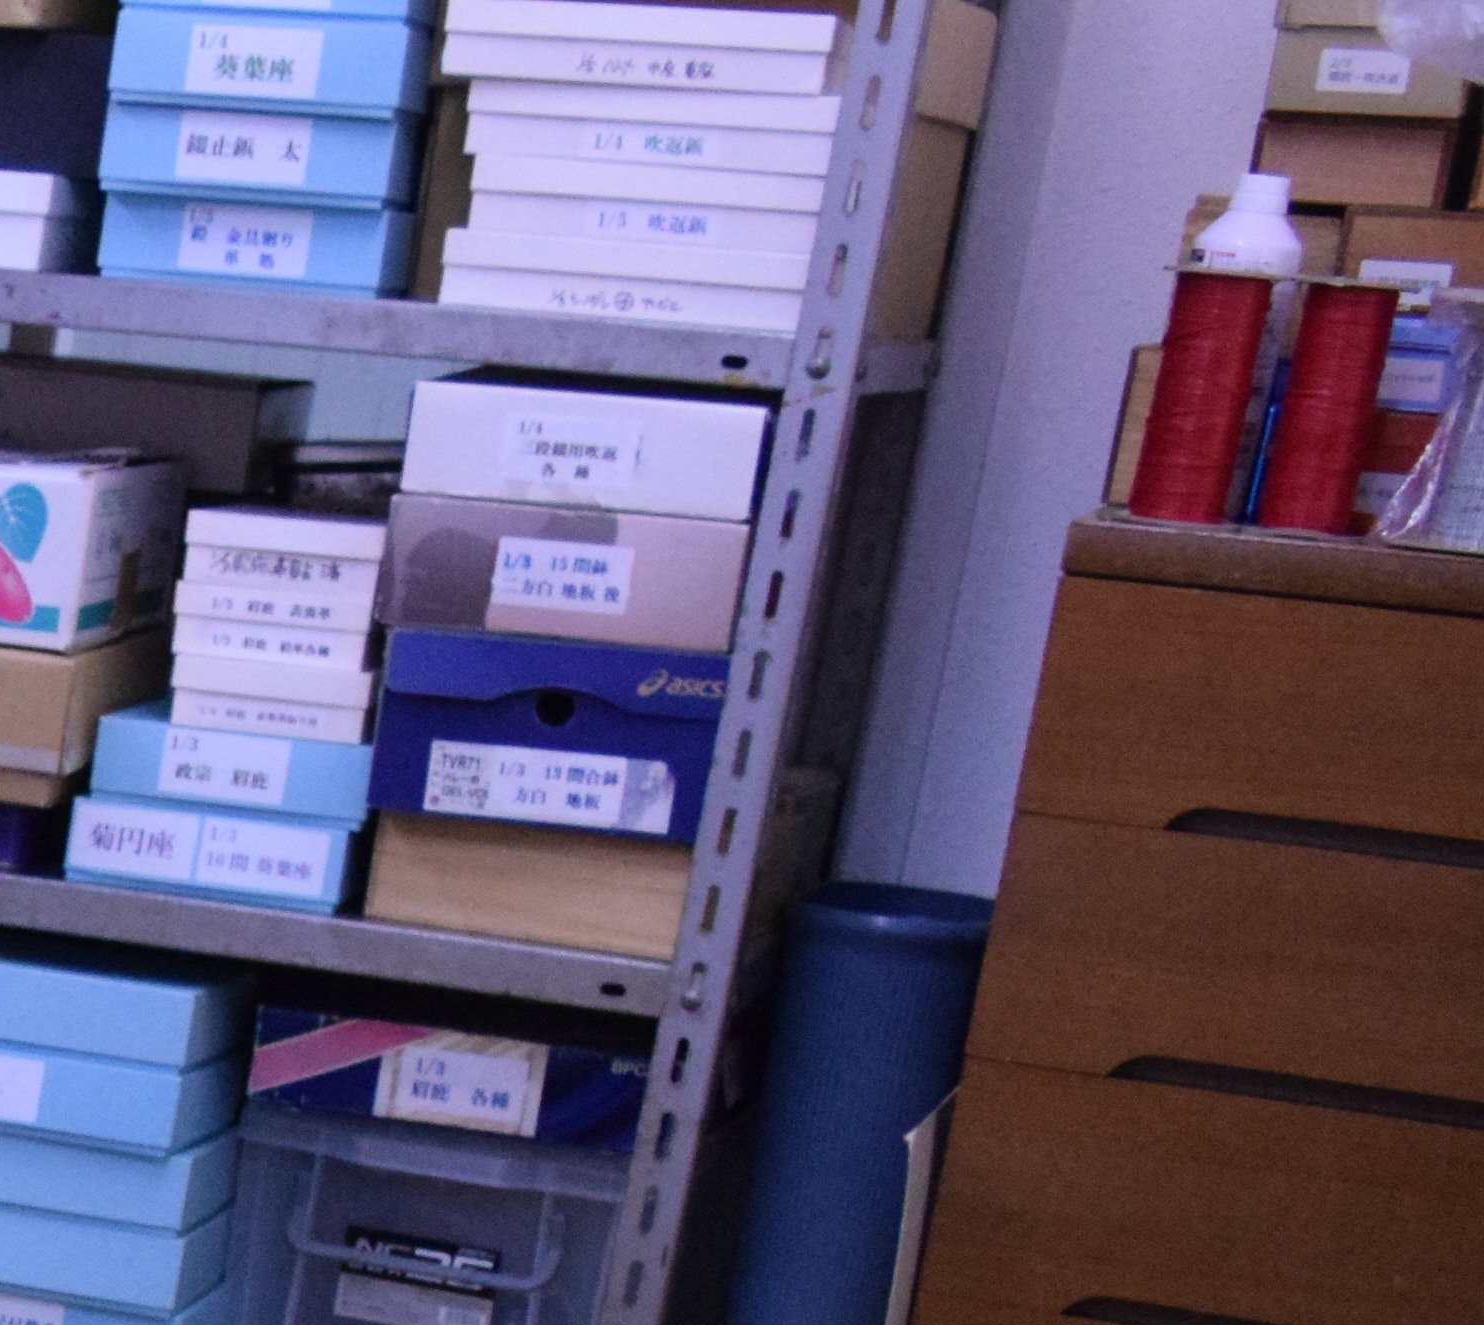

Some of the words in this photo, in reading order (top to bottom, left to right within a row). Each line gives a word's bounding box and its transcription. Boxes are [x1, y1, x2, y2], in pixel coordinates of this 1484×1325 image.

[665, 676, 726, 698] asics
[88, 822, 175, 860] 菊円座
